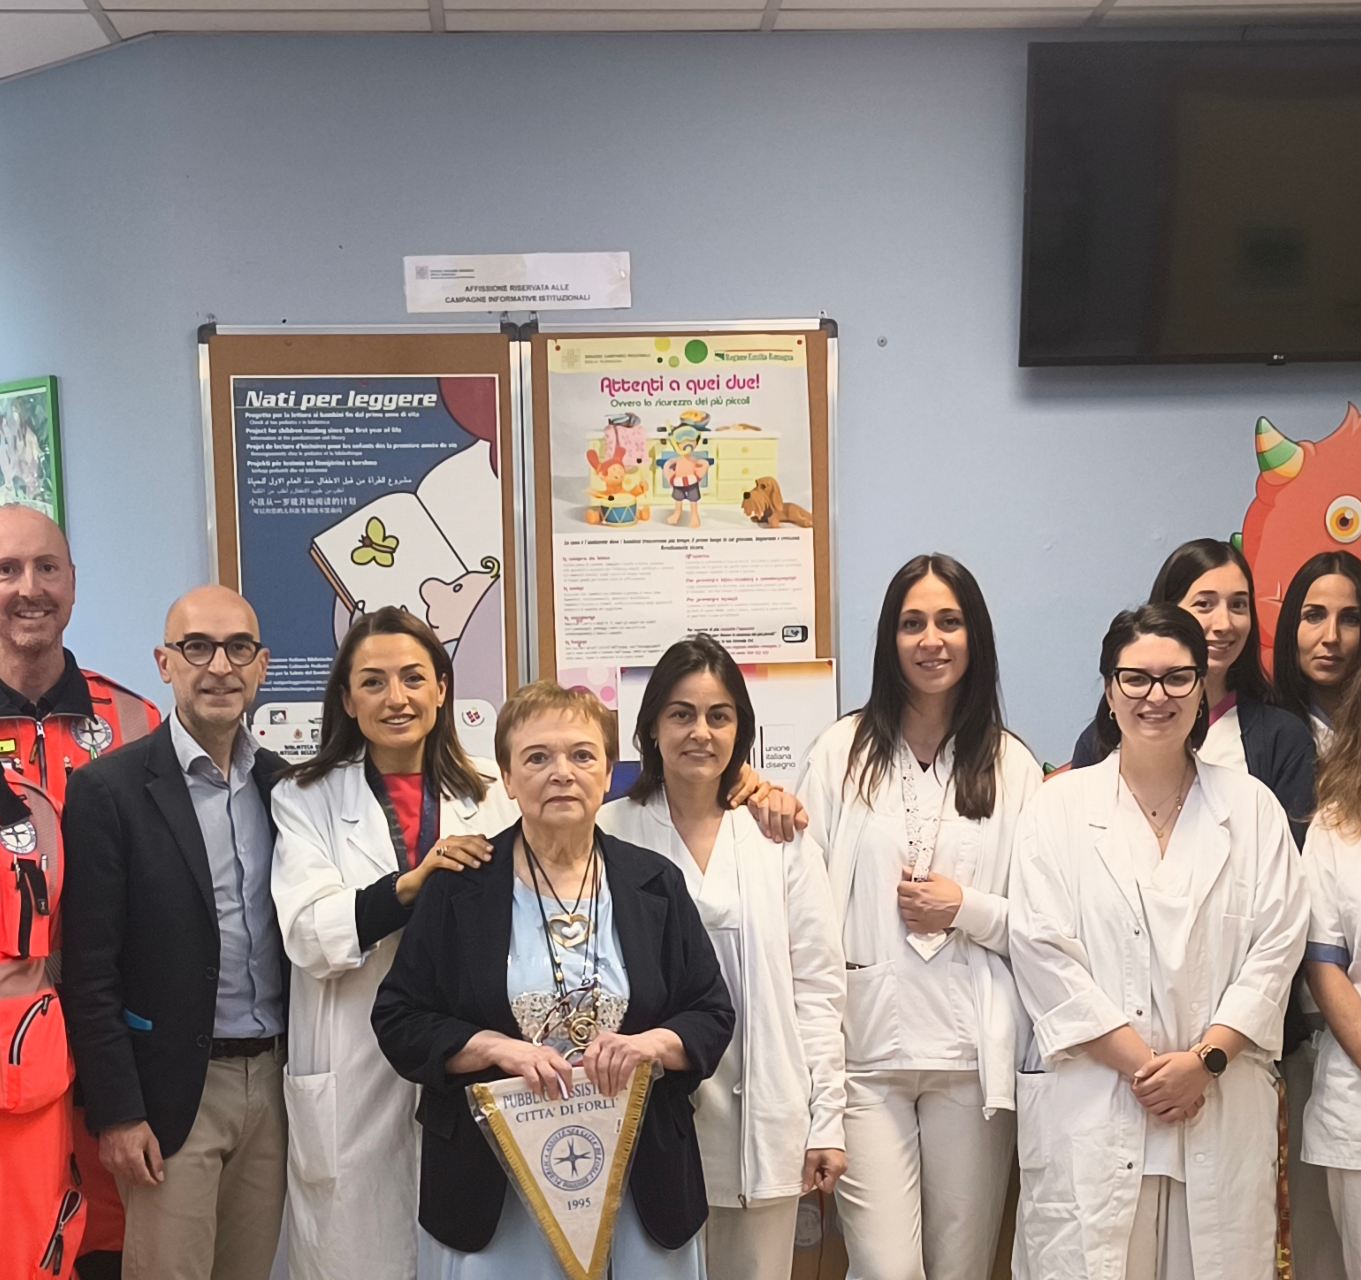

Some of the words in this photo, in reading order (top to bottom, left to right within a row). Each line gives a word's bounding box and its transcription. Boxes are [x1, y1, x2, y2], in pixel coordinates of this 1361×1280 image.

[510, 284, 550, 292] RISERVATA
[551, 283, 570, 291] ALLE
[488, 295, 537, 303] INFORMATIVE
[601, 375, 664, 397] Attenti
[669, 379, 680, 391] a
[686, 374, 720, 395] quei
[726, 373, 761, 390] due!
[245, 390, 296, 407] Nati
[300, 393, 342, 411] per
[347, 390, 437, 411] leggere
[610, 398, 641, 408] Ovvero
[643, 398, 652, 407] la
[655, 398, 693, 407] sicurezza
[695, 396, 708, 406] dei
[725, 395, 751, 407] piccoli
[765, 752, 792, 760] italiana
[765, 760, 796, 770] disegno
[515, 1106, 556, 1123] CITTA'
[560, 1104, 574, 1116] DI
[577, 1097, 619, 1113] FORLI'
[566, 1197, 591, 1211] 1995
